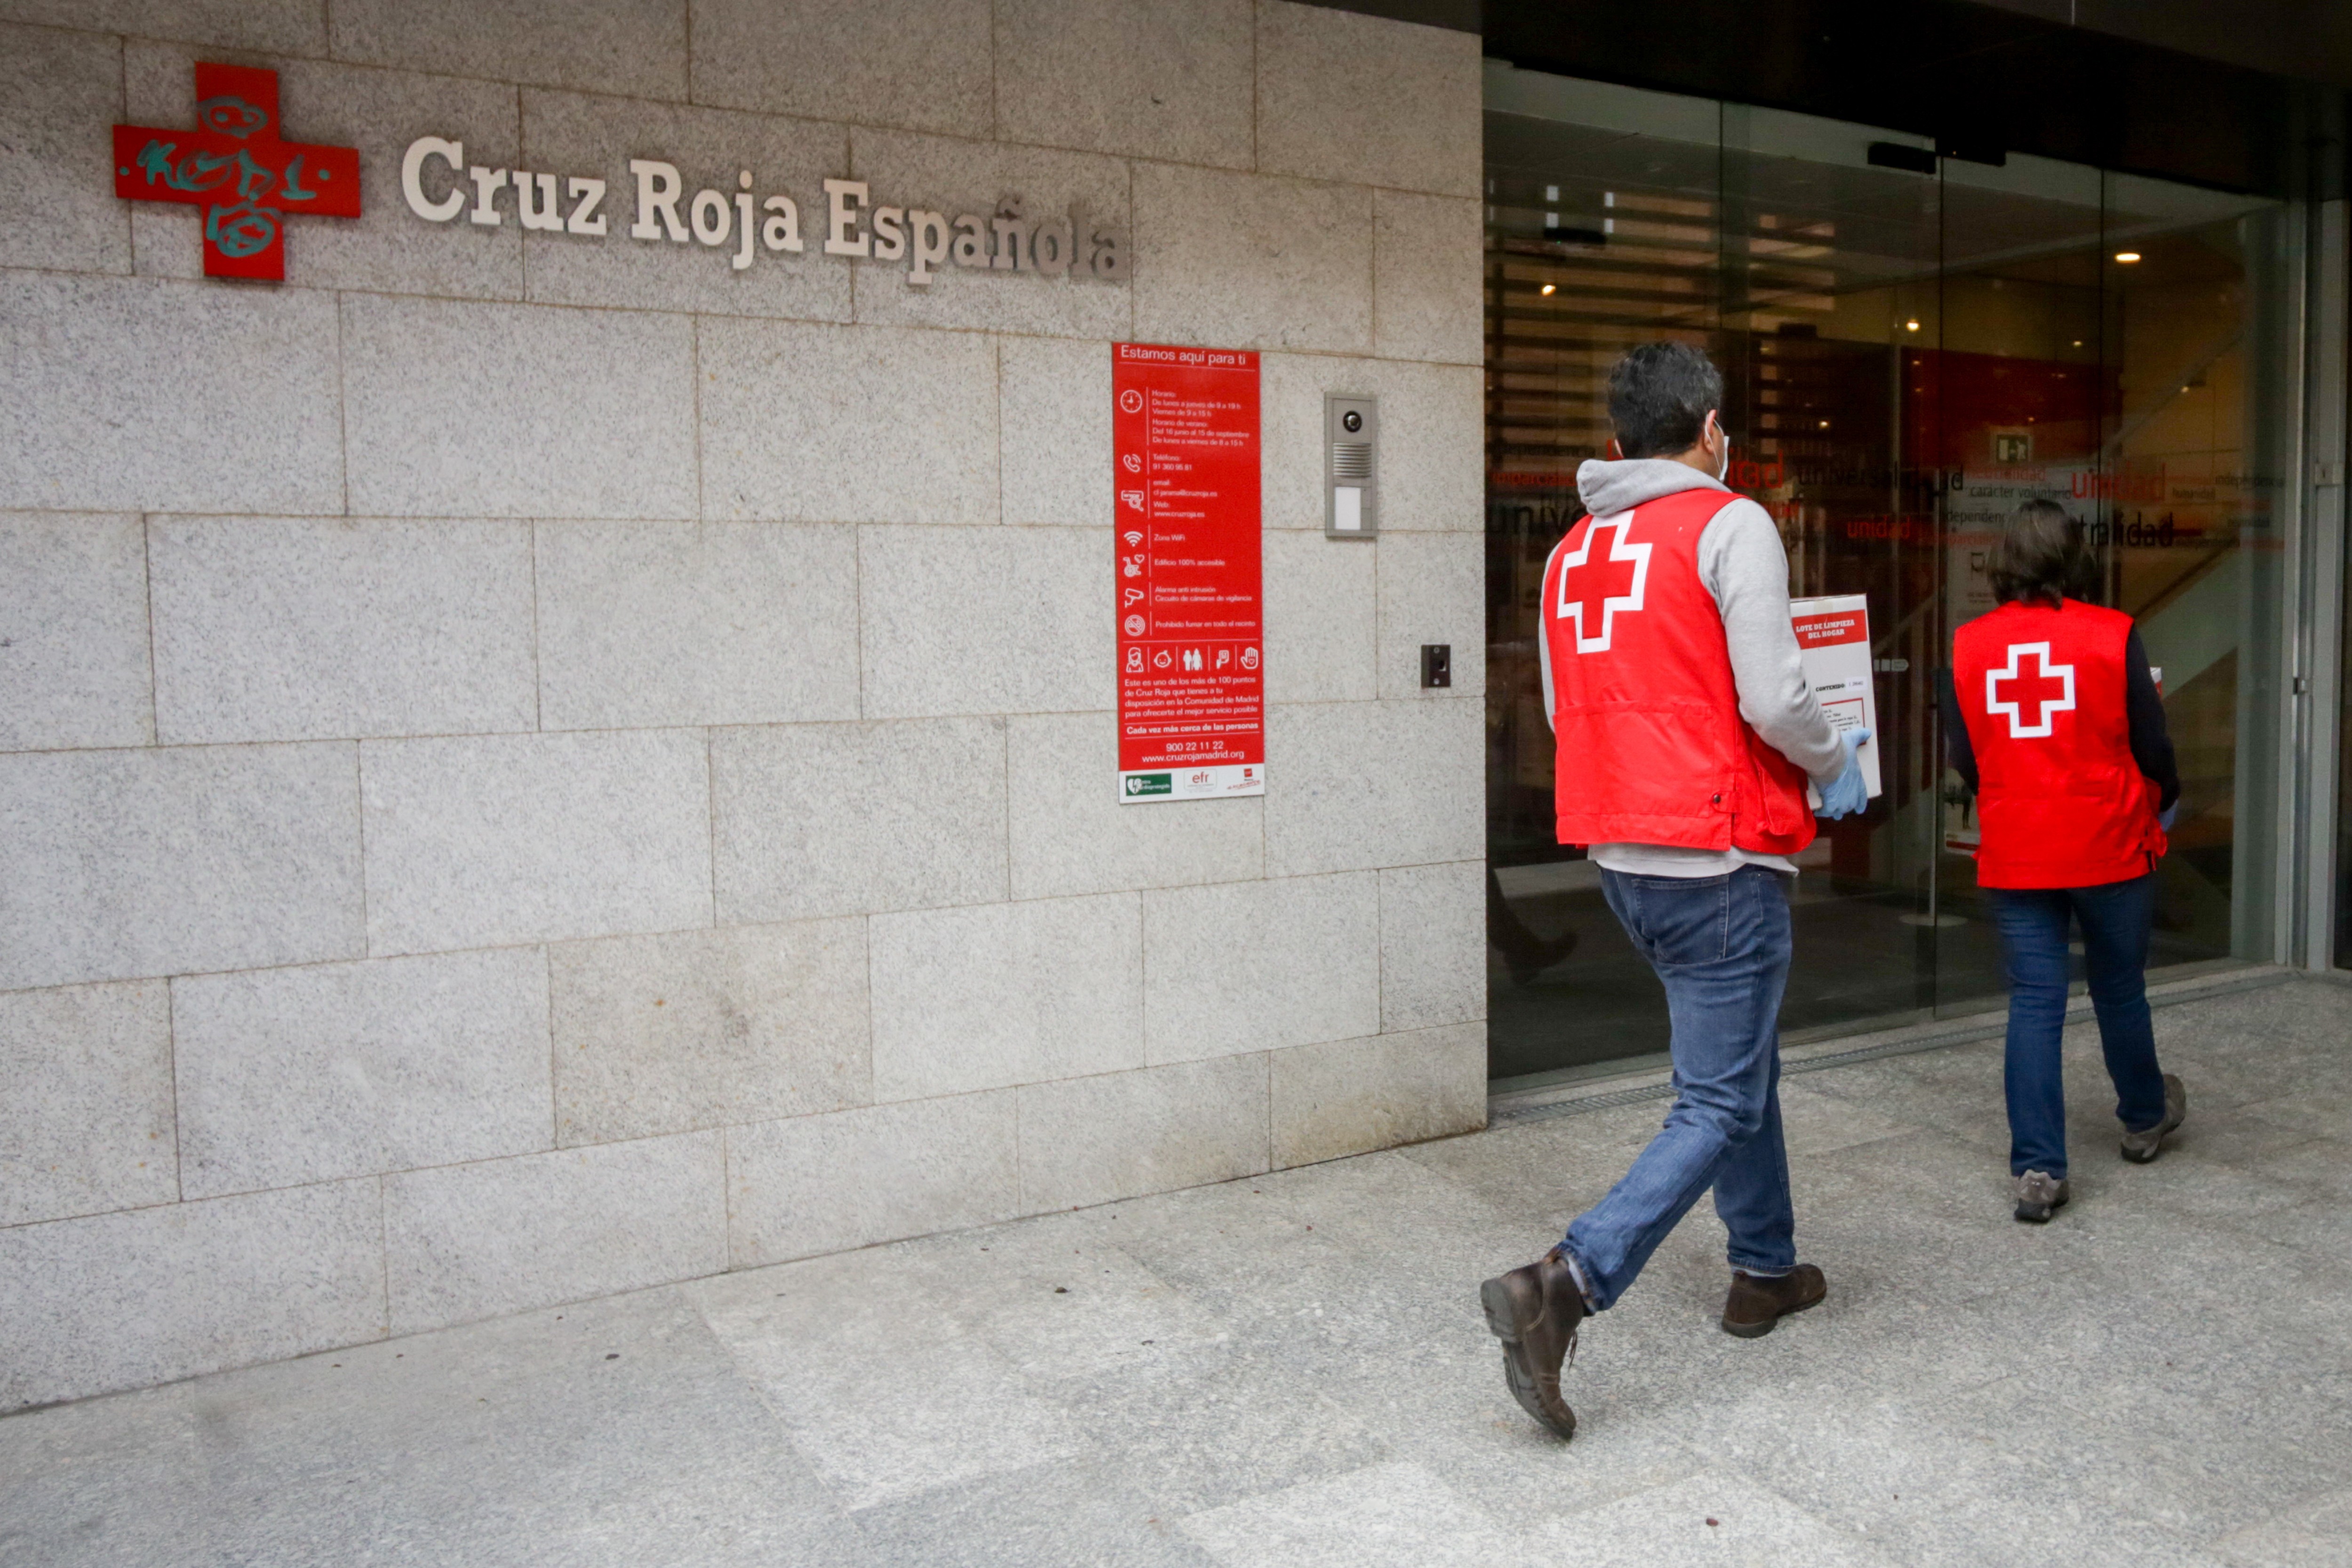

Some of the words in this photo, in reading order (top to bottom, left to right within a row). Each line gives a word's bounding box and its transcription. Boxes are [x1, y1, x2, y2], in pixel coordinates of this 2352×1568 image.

[402, 136, 606, 235] Cruz
[630, 159, 803, 270] Roja
[824, 179, 1130, 284] Española
[1121, 346, 1175, 360] Estamos
[1180, 350, 1205, 364] aquí
[1208, 354, 1235, 365] para
[1238, 354, 1245, 365] ti
[2072, 461, 2167, 502] unidad
[2017, 484, 2071, 500] voluntario
[1824, 619, 1855, 629] LIMPIEZA
[1155, 688, 1171, 697] Roja
[1125, 699, 1164, 708] disposición
[1184, 697, 1224, 705] Comunidad
[1234, 706, 1258, 714] posible
[1166, 743, 1183, 752] 900
[1186, 742, 1196, 751] 22
[1213, 741, 1223, 750] 22
[1142, 750, 1244, 762] www.cruzrojamadrid.org
[1192, 772, 1209, 783] efr
